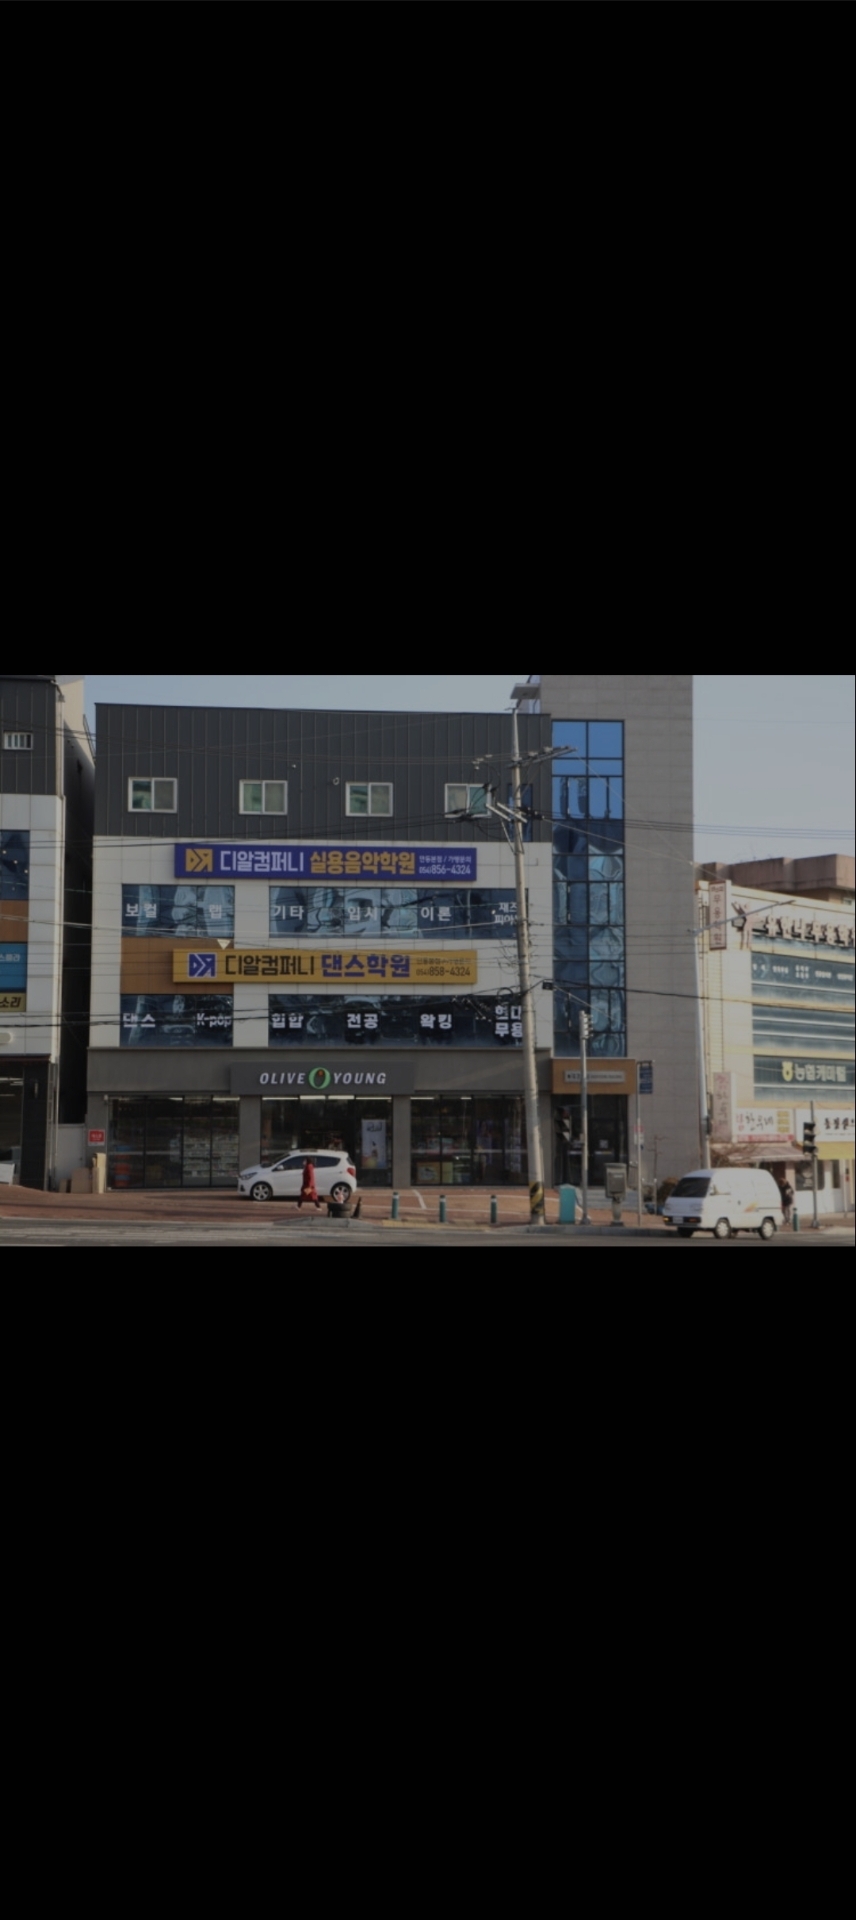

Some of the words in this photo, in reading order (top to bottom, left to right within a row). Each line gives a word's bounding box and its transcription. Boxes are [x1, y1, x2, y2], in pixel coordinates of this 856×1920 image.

[220, 850, 304, 872] 디알컴퍼니
[309, 851, 415, 875] 실용음악학원
[125, 903, 157, 918] 보컬
[209, 904, 222, 919] 랩
[272, 905, 304, 920] 기타
[347, 906, 378, 921] 입시
[420, 906, 452, 921] 이론
[495, 914, 517, 926] 피아
[225, 955, 315, 976] 디알컴퍼니
[321, 954, 410, 978] 댄스학원
[123, 1012, 156, 1028] 댄스
[197, 1012, 232, 1028] K-pop
[271, 1013, 304, 1029] 힙합
[347, 1013, 379, 1029] 전공
[420, 1013, 452, 1029] 왁킹
[259, 1072, 306, 1085] OLIVE
[333, 1072, 387, 1085] YOUNG
